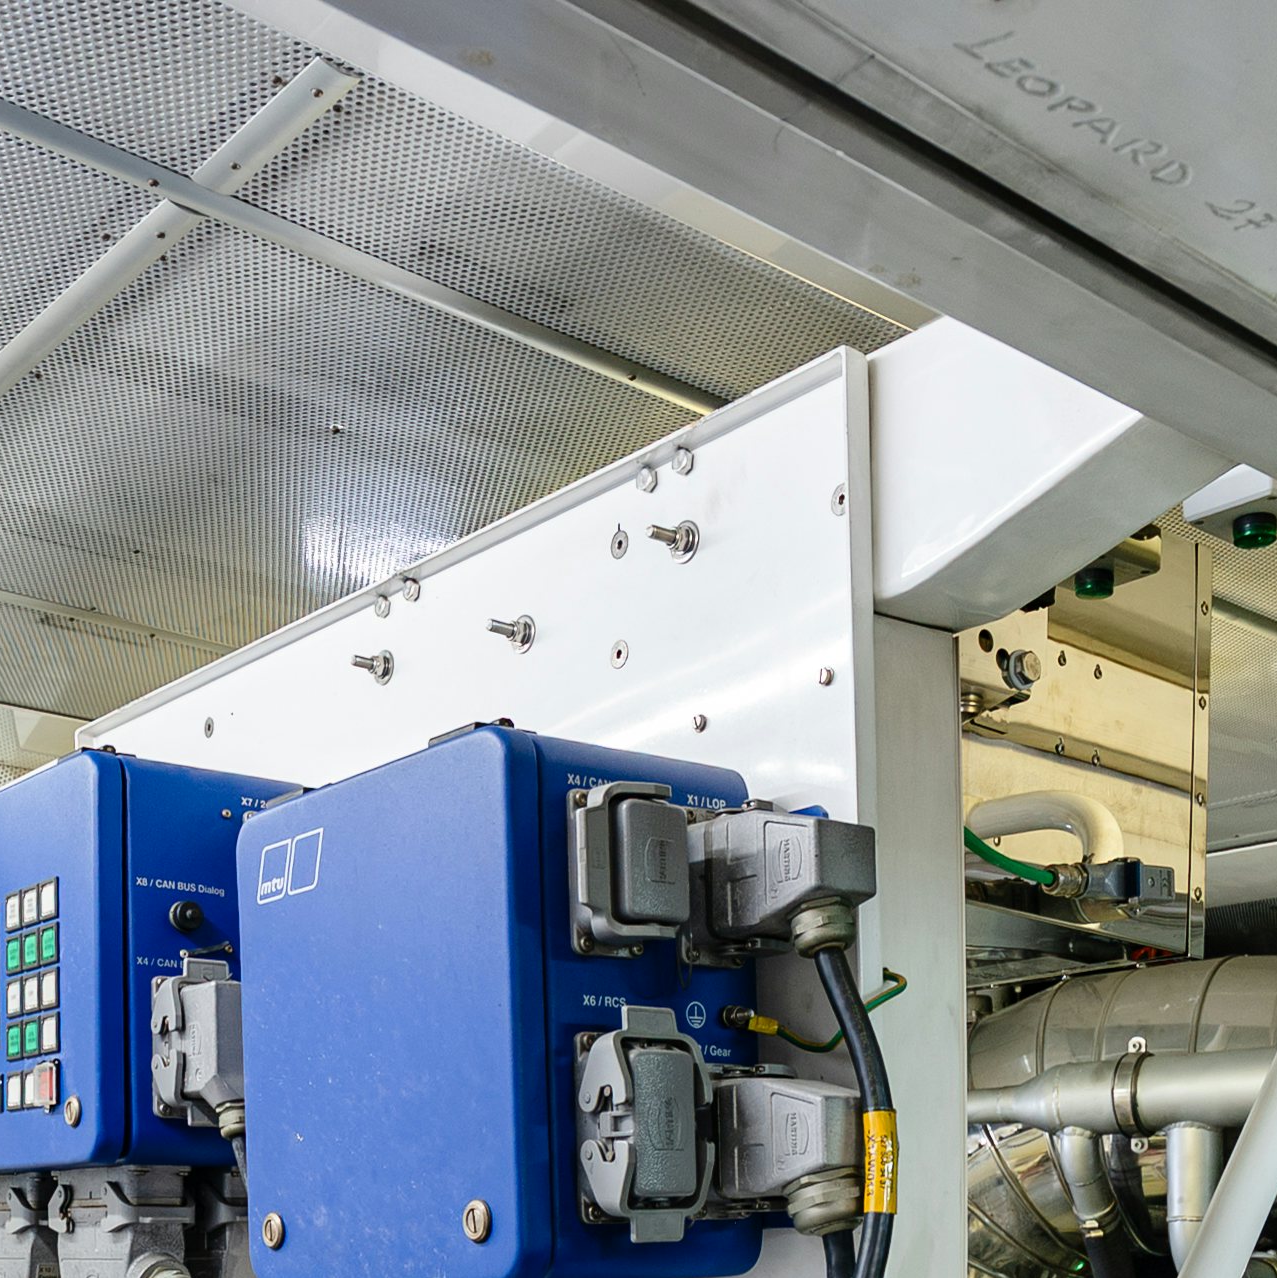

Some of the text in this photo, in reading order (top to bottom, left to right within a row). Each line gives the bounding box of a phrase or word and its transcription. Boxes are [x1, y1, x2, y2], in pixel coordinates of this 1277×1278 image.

[953, 30, 1192, 188] LEOPARD
[567, 773, 581, 785] X4
[241, 797, 253, 806] X7
[687, 794, 698, 806] X1
[706, 797, 727, 810] LOP
[136, 877, 149, 887] X8
[155, 879, 176, 890] CAN
[177, 881, 197, 892] BUS
[198, 884, 225, 898] Dialog
[261, 876, 285, 897] mtu
[136, 956, 150, 967] X4
[157, 958, 178, 969] CAN
[583, 994, 597, 1007] X6
[604, 996, 626, 1008] RCS
[709, 1044, 732, 1058] Gear
